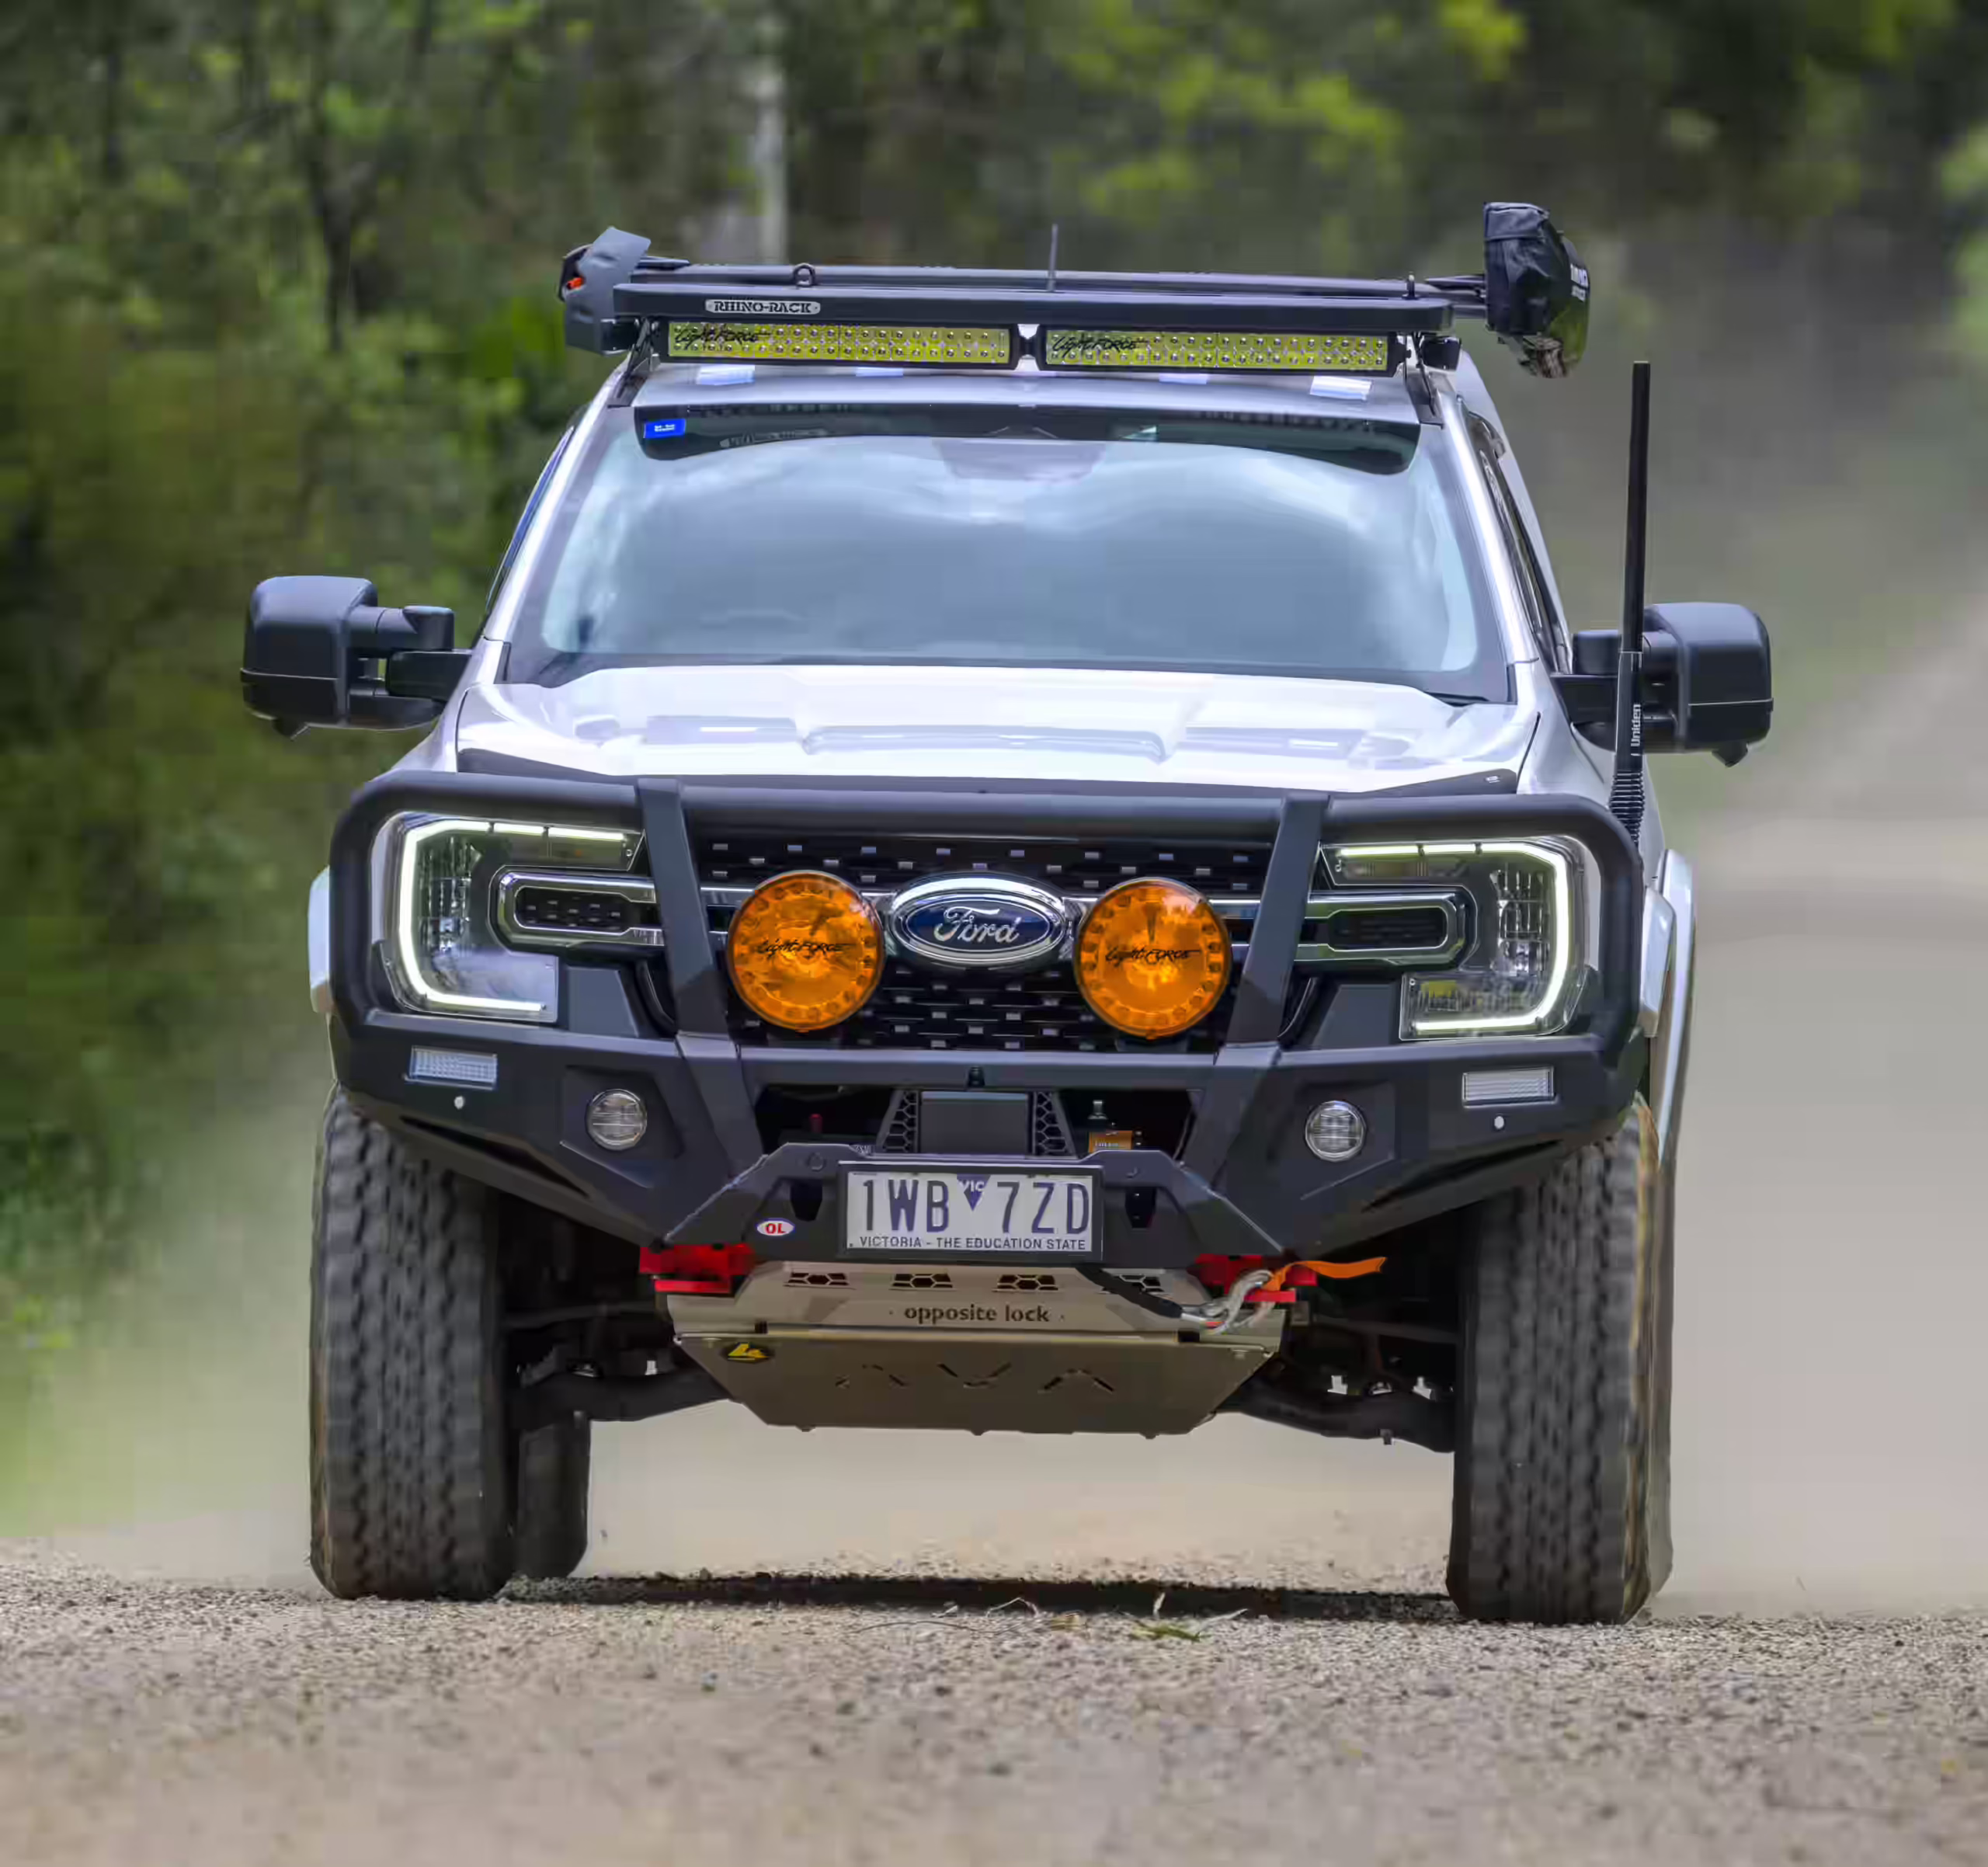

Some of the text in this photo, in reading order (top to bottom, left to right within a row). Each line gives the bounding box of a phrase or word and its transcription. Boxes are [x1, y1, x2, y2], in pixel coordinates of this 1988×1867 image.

[714, 300, 812, 314] RHINO-RACK
[1630, 703, 1642, 747] Uniden
[933, 906, 1021, 943] Ford
[958, 1180, 985, 1192] VIC
[862, 1178, 1090, 1235] 1WB 7ZD
[765, 1222, 785, 1235] OL
[859, 1236, 922, 1248] VICTORIA
[937, 1236, 961, 1249] THE
[966, 1237, 1042, 1250] EDUCATION
[1046, 1239, 1086, 1250] STATE
[904, 1303, 1050, 1325] opposite lock
